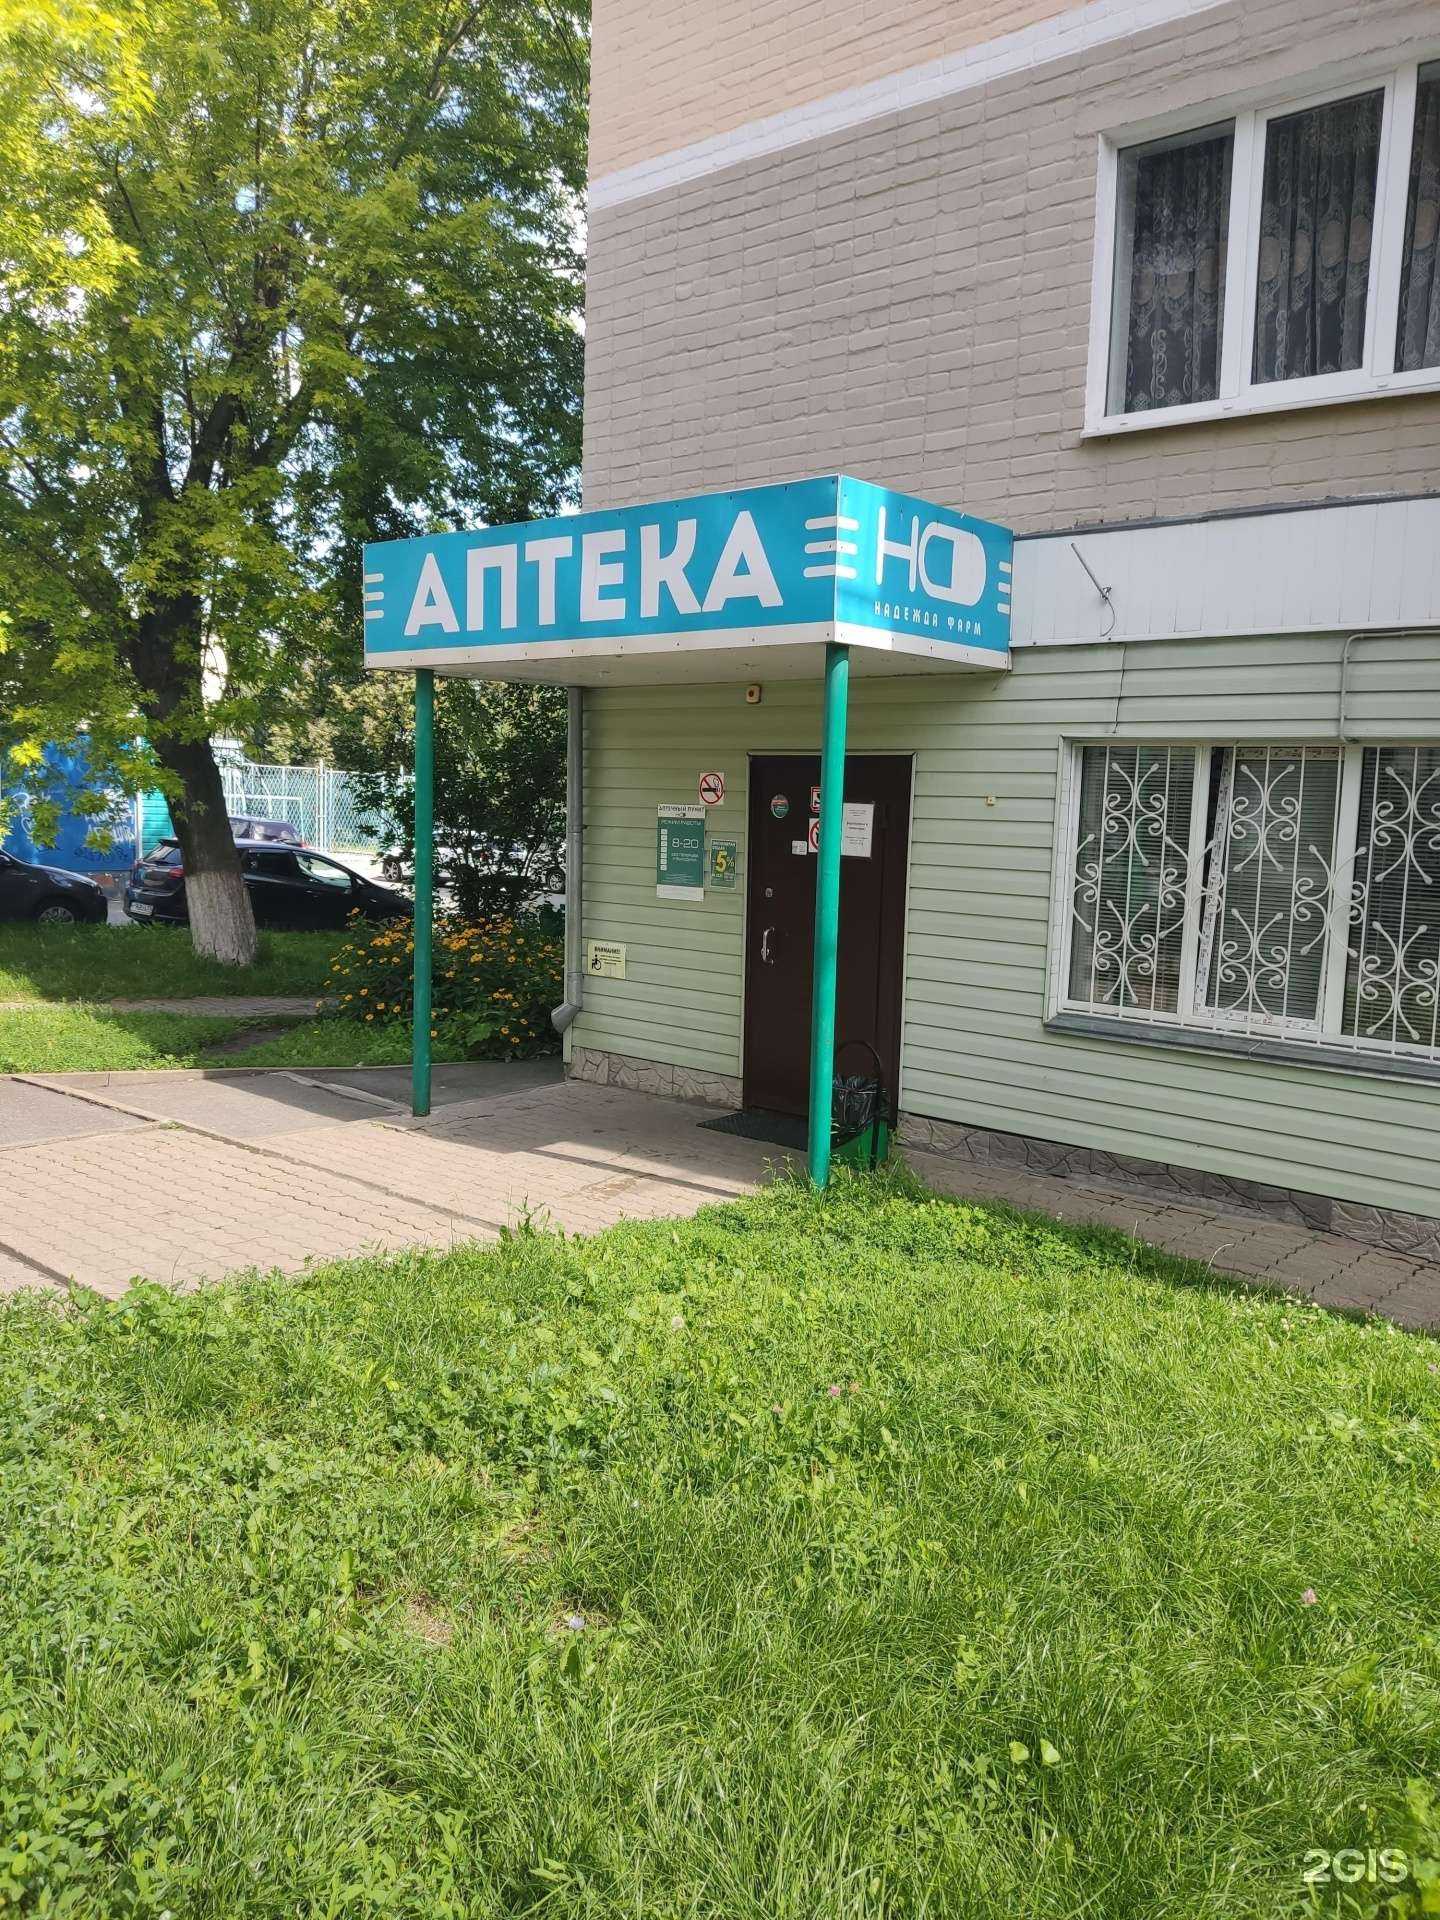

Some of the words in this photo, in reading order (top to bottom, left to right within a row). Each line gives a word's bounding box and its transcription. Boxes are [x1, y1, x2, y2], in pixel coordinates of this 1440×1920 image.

[404, 510, 784, 636] АПТЕКА
[874, 600, 938, 628] НАДЕЖДА
[947, 616, 981, 636] ФАРМ
[672, 838, 699, 849] 8-20
